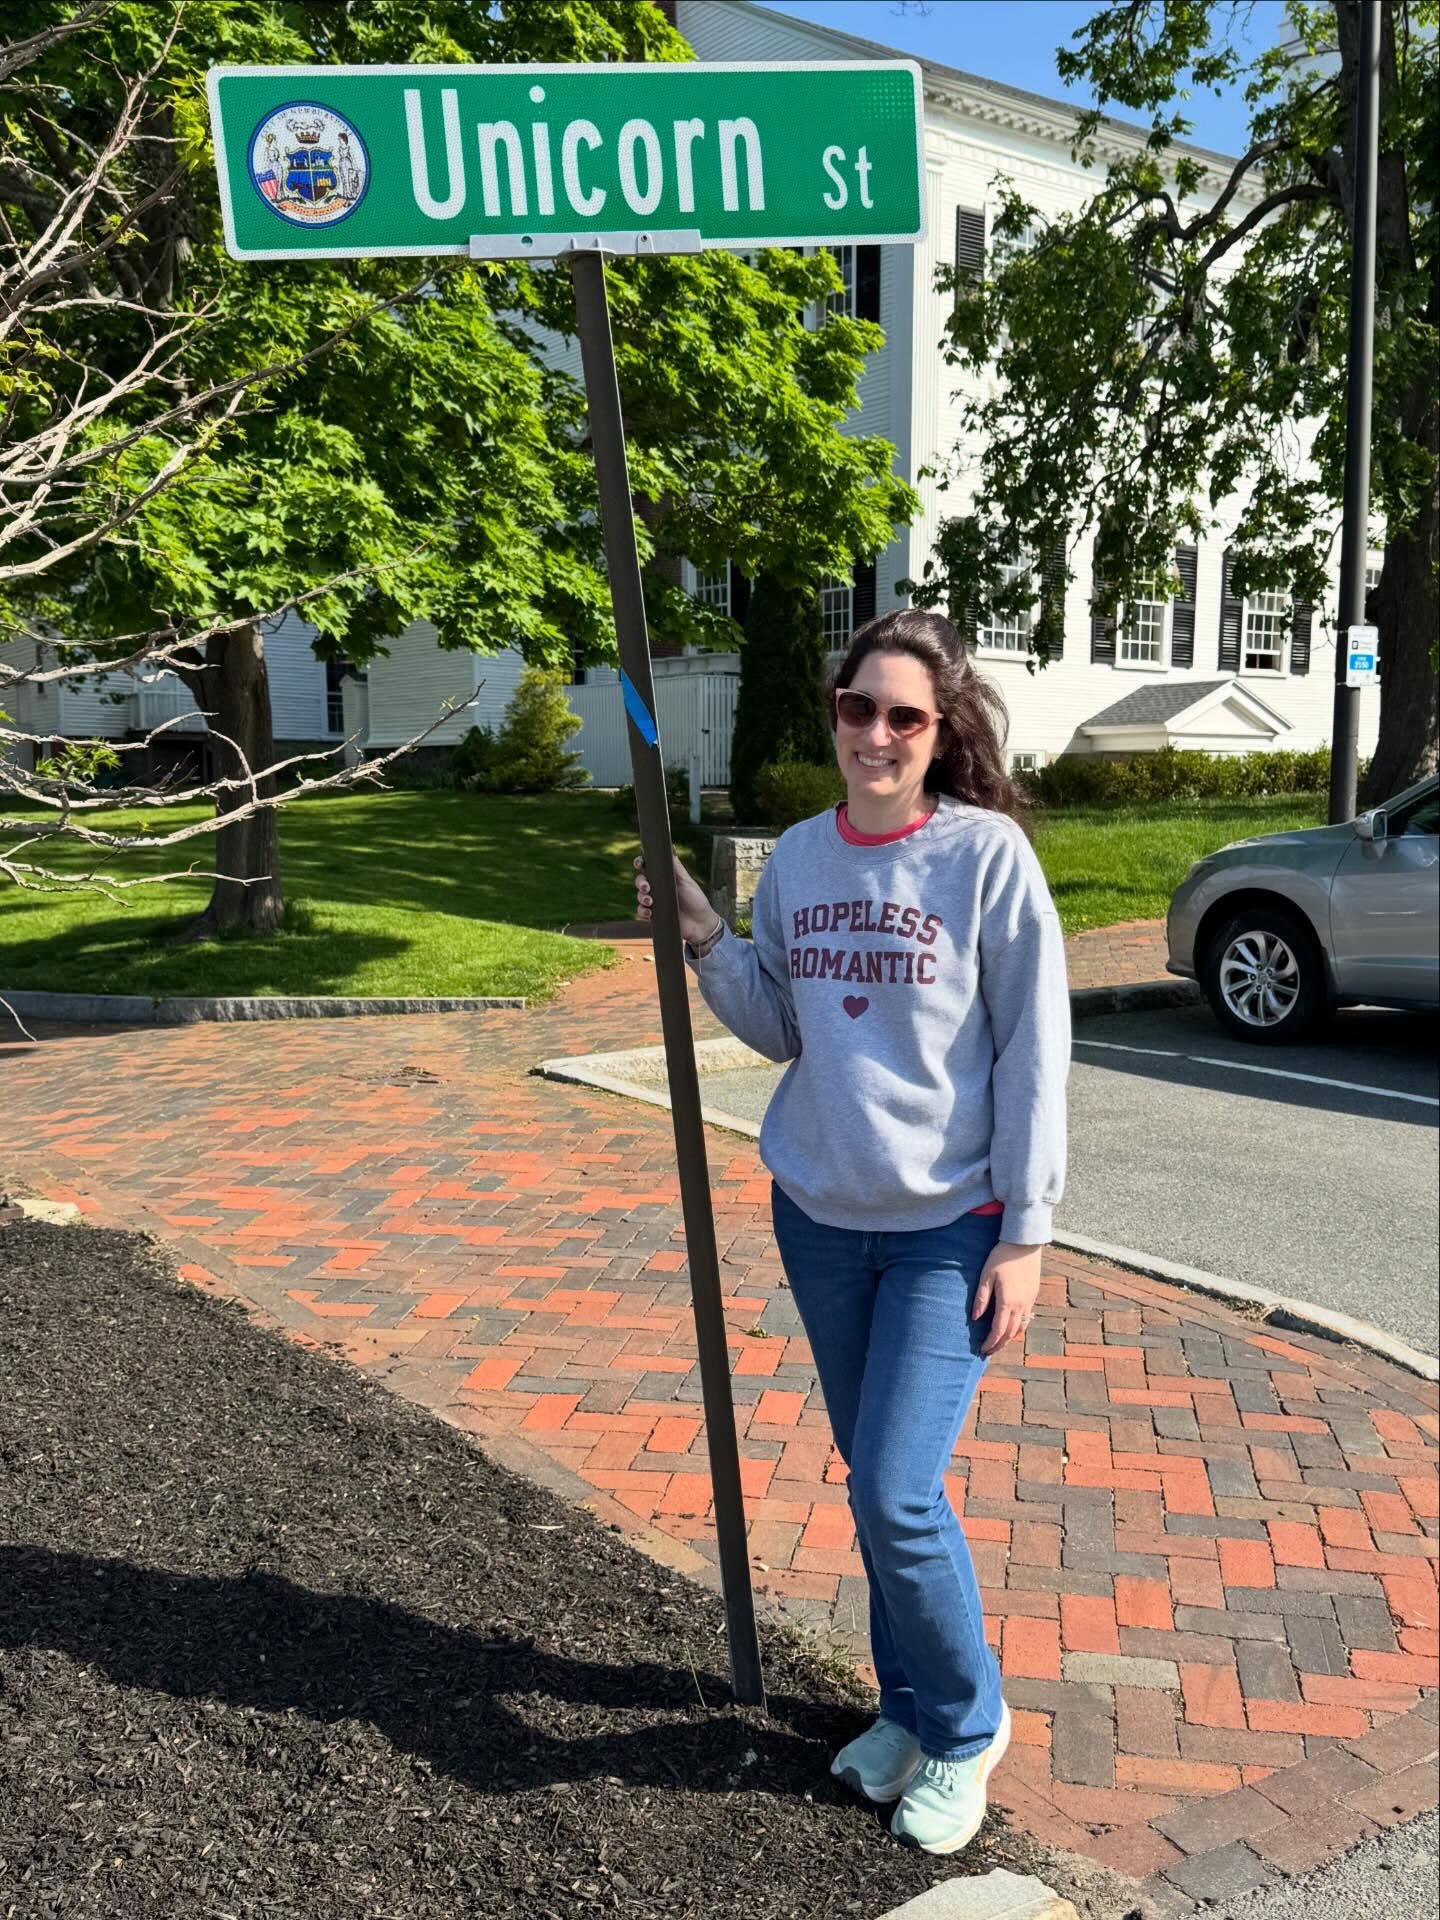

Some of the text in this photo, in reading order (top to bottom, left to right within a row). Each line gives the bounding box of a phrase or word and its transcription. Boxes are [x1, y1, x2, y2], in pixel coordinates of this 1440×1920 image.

[403, 85, 874, 220] Unicorn St
[792, 899, 944, 946] HOPELESS
[790, 947, 937, 985] ROMANTIC
